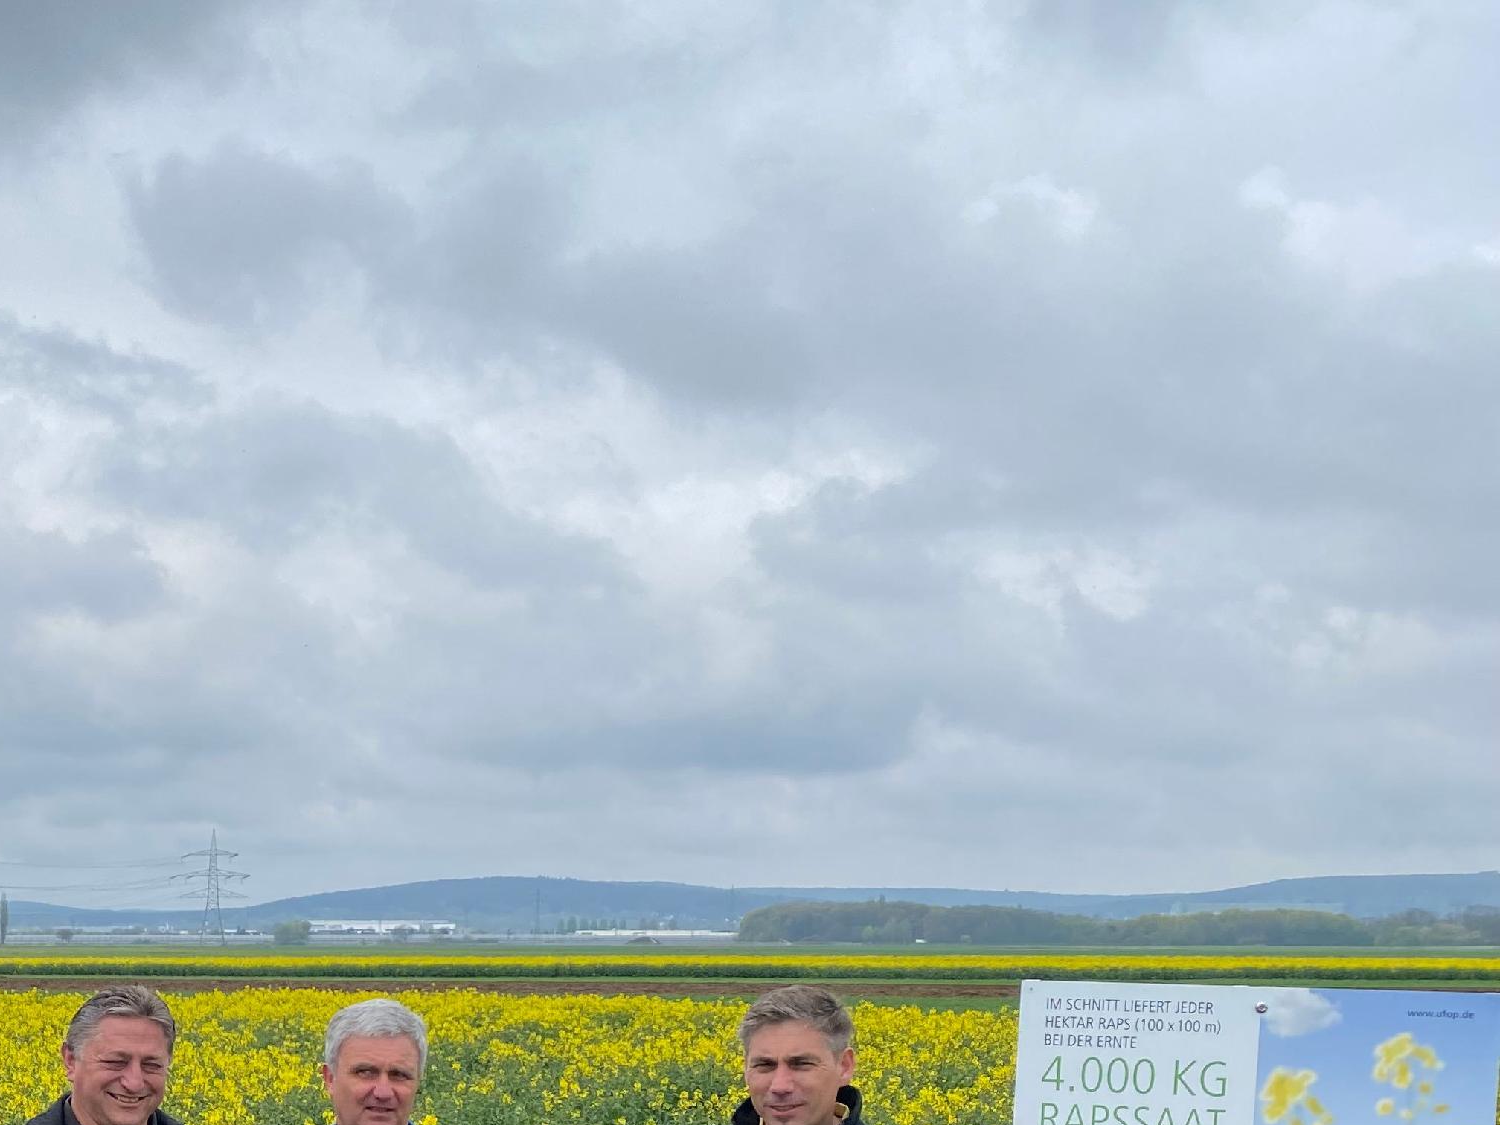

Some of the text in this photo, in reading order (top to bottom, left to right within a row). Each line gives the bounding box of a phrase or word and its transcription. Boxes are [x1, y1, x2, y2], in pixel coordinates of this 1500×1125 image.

[1046, 998, 1213, 1015] IM SCHNITT LIEFERT JEDER
[1408, 1010, 1475, 1019] www.ufop.de
[1045, 1016, 1221, 1035] HEKTAR RAPS (100 x 100 m)
[1044, 1034, 1137, 1048] BEI DER ERNTE
[1041, 1055, 1229, 1098] 4.000 KG
